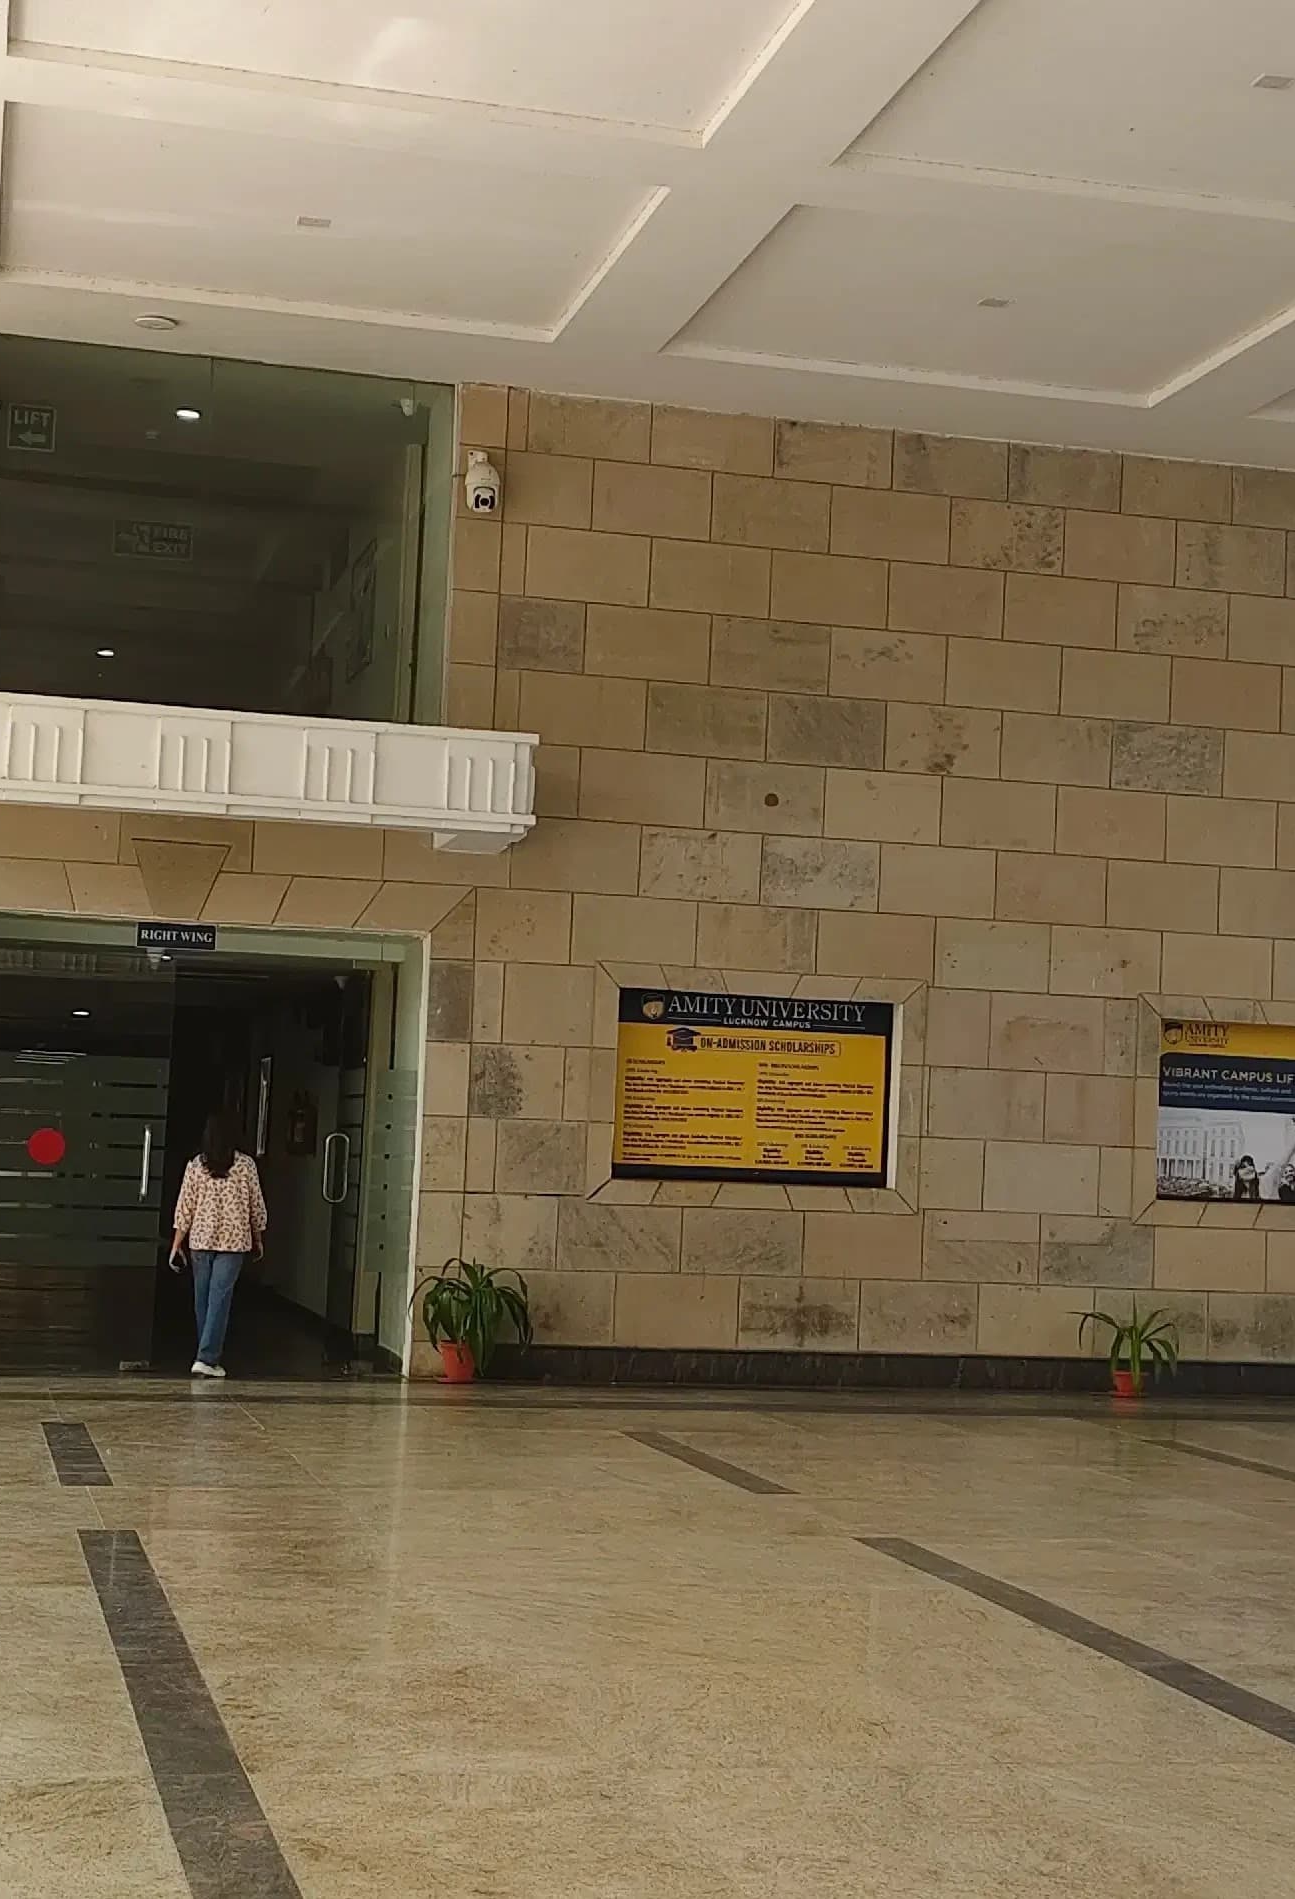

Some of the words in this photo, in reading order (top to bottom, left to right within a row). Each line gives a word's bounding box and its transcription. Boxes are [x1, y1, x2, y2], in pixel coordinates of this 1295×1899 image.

[14, 408, 51, 427] LIFT
[141, 929, 179, 941] RIGHT
[180, 931, 213, 943] WING
[667, 995, 737, 1015] AMITY
[740, 998, 866, 1023] UNIVERSITY
[723, 1017, 769, 1028] LUCKNOW
[772, 1019, 811, 1029] CAMPUS
[1185, 1023, 1230, 1037] AMITY
[700, 1037, 766, 1052] ON-ADMISSION
[768, 1040, 836, 1055] SCHOLARSHIPS
[1162, 1066, 1218, 1080] VIBRANT
[1220, 1070, 1274, 1083] CAMPUS
